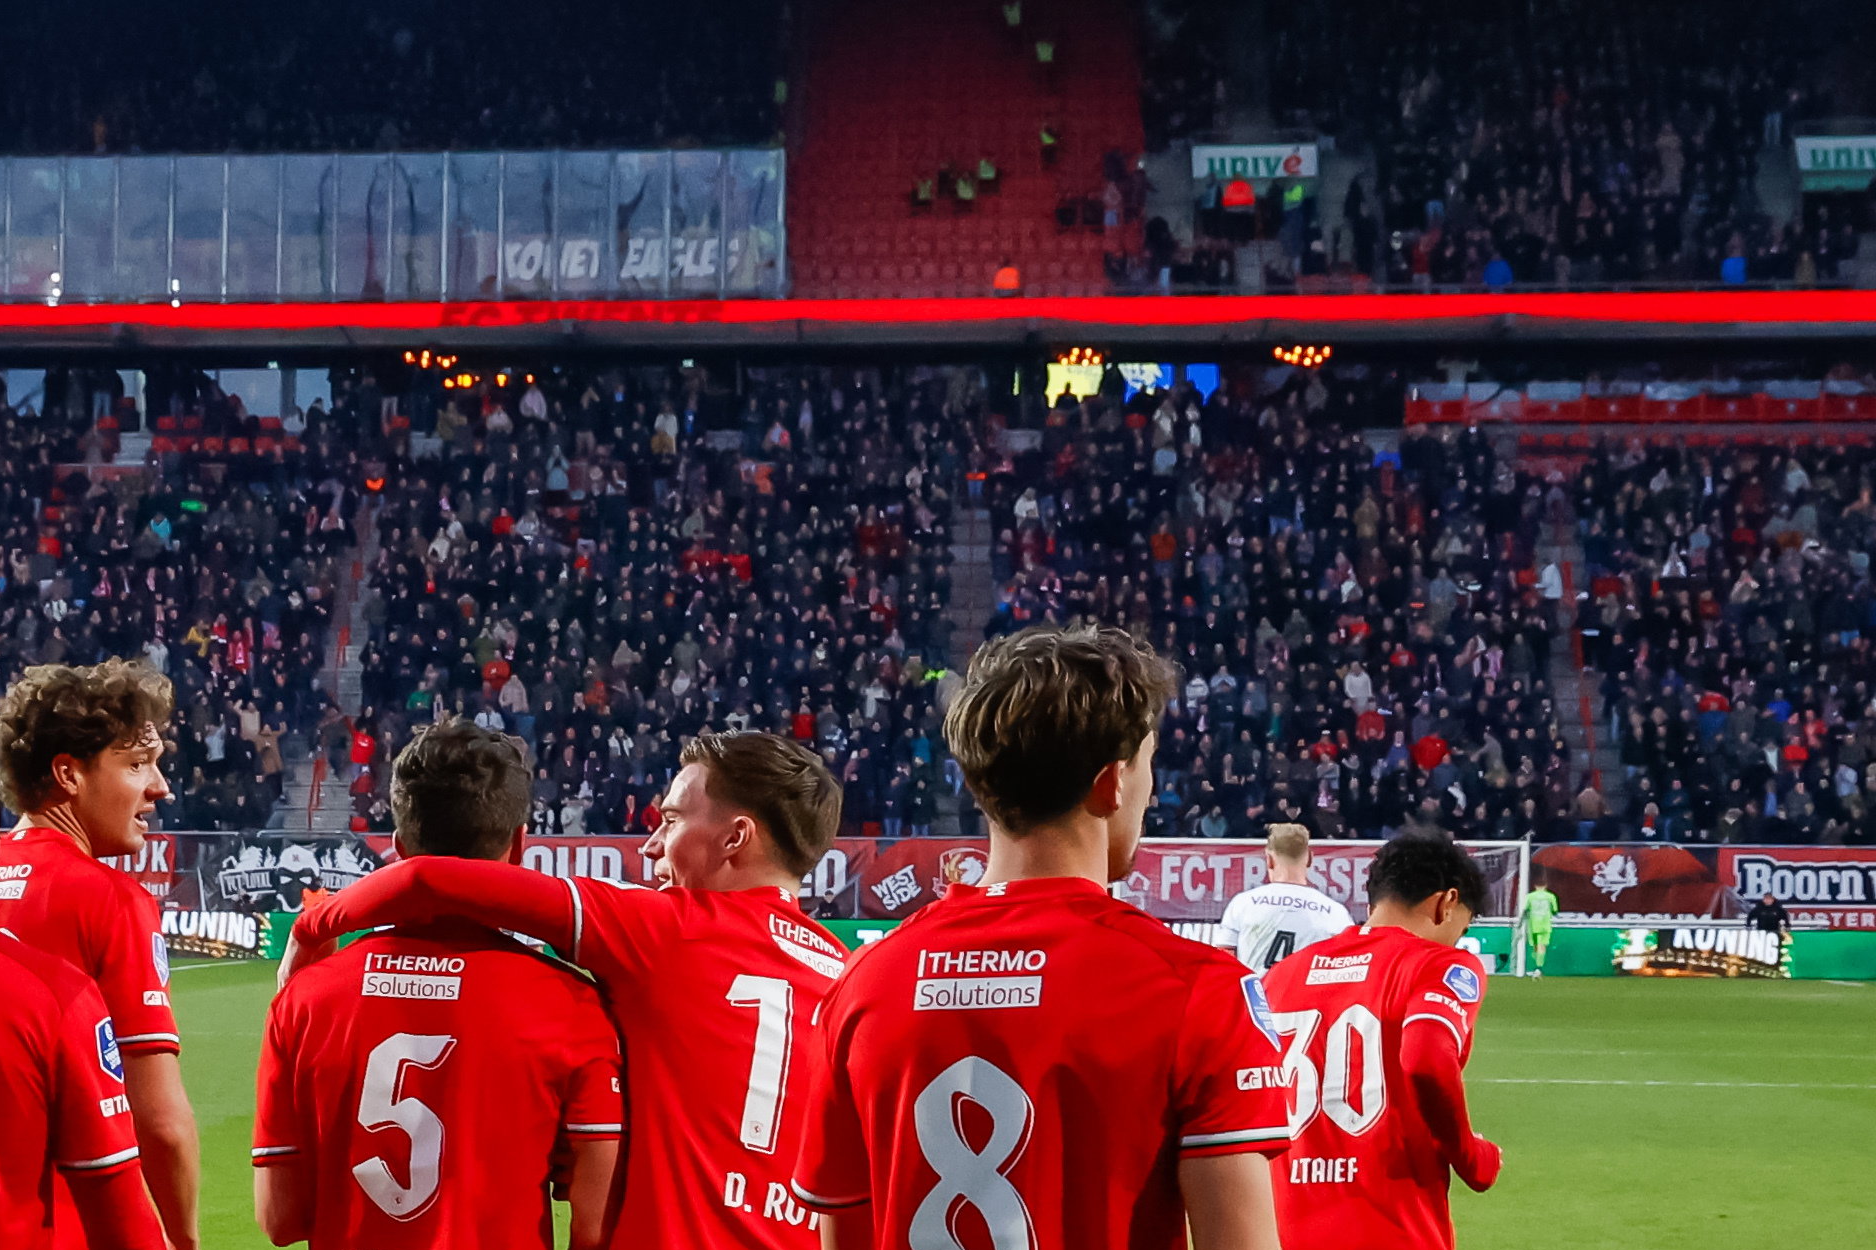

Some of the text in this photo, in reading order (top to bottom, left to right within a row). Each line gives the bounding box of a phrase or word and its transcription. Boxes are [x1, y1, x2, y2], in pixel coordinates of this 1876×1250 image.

[870, 864, 916, 899] WEST
[881, 873, 923, 912] SIDE
[1161, 854, 1231, 902] FCT
[1251, 895, 1332, 915] VALIDSIGN
[365, 975, 456, 999] Solutions
[918, 980, 1036, 1008] Solutions
[726, 974, 794, 1154] 1
[1274, 1004, 1387, 1141] 30
[352, 1032, 458, 1222] 5
[724, 1171, 753, 1213] D.
